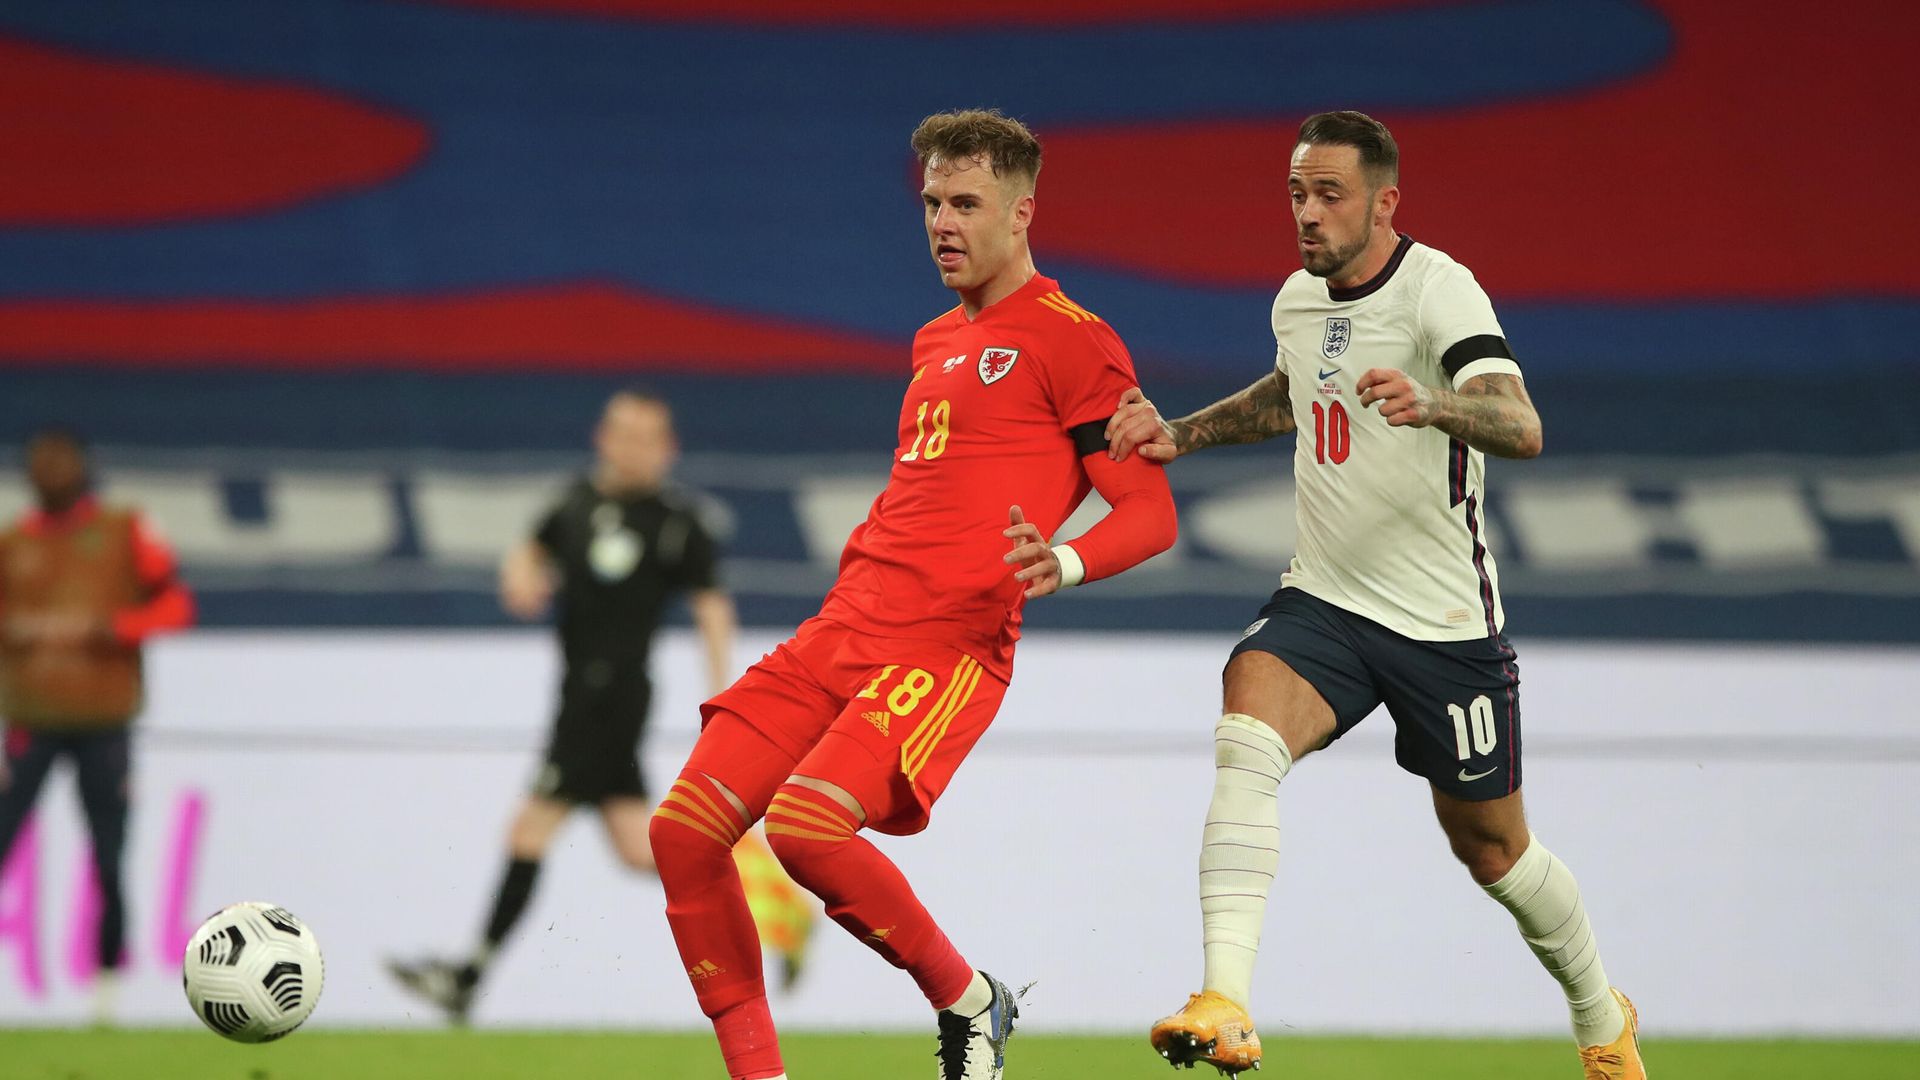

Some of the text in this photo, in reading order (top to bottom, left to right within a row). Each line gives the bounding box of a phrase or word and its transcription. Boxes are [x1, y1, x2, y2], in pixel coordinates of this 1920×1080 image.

[899, 399, 951, 462] 18
[1312, 400, 1350, 465] 10
[856, 665, 935, 717] 18
[861, 711, 890, 737] adidas
[1447, 694, 1498, 761] 10
